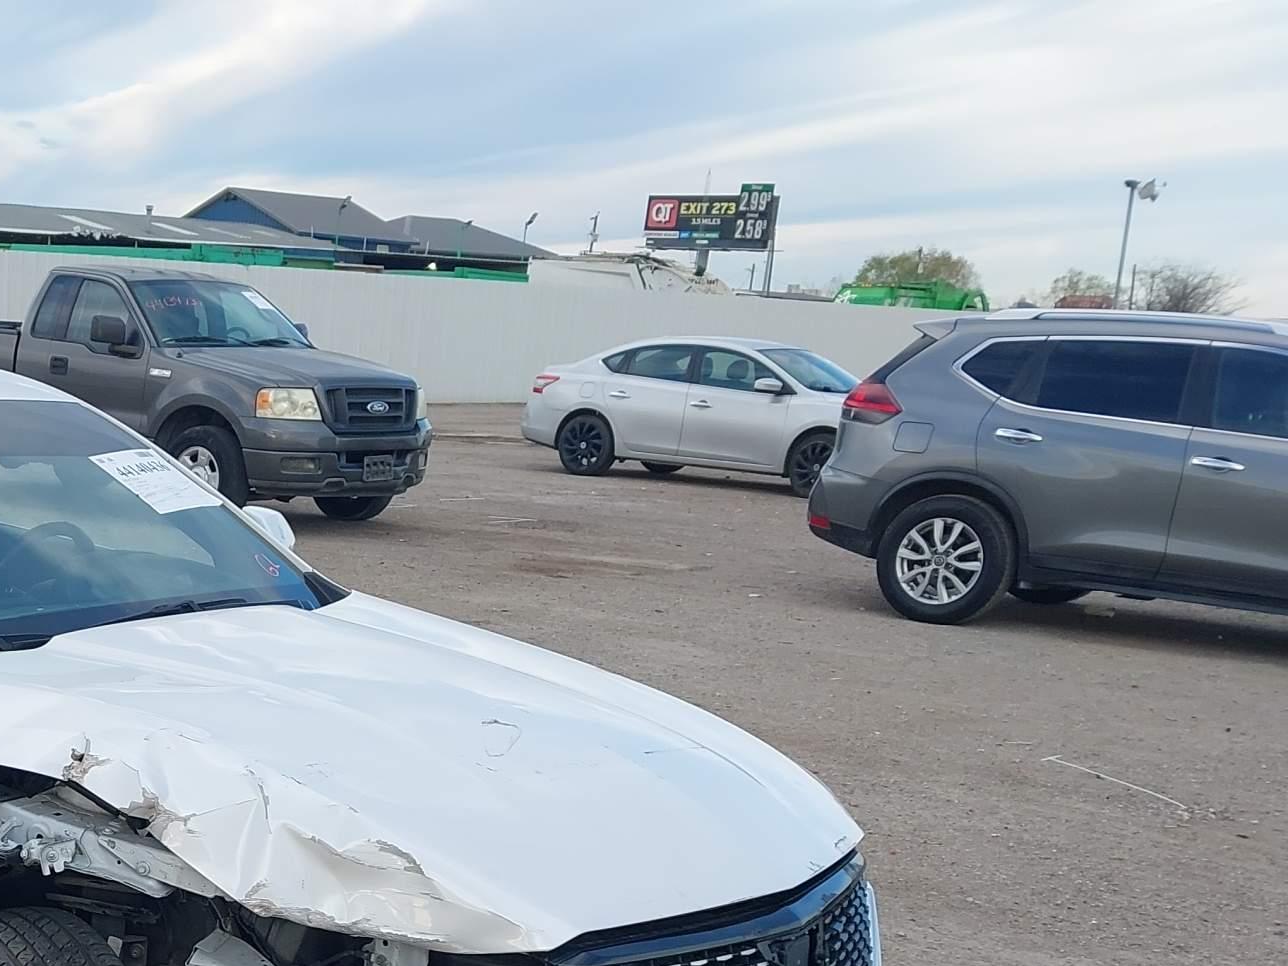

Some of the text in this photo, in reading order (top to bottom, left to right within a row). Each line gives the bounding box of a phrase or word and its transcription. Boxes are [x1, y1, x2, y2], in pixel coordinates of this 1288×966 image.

[652, 203, 674, 224] QT
[680, 202, 737, 215] EXIT 273
